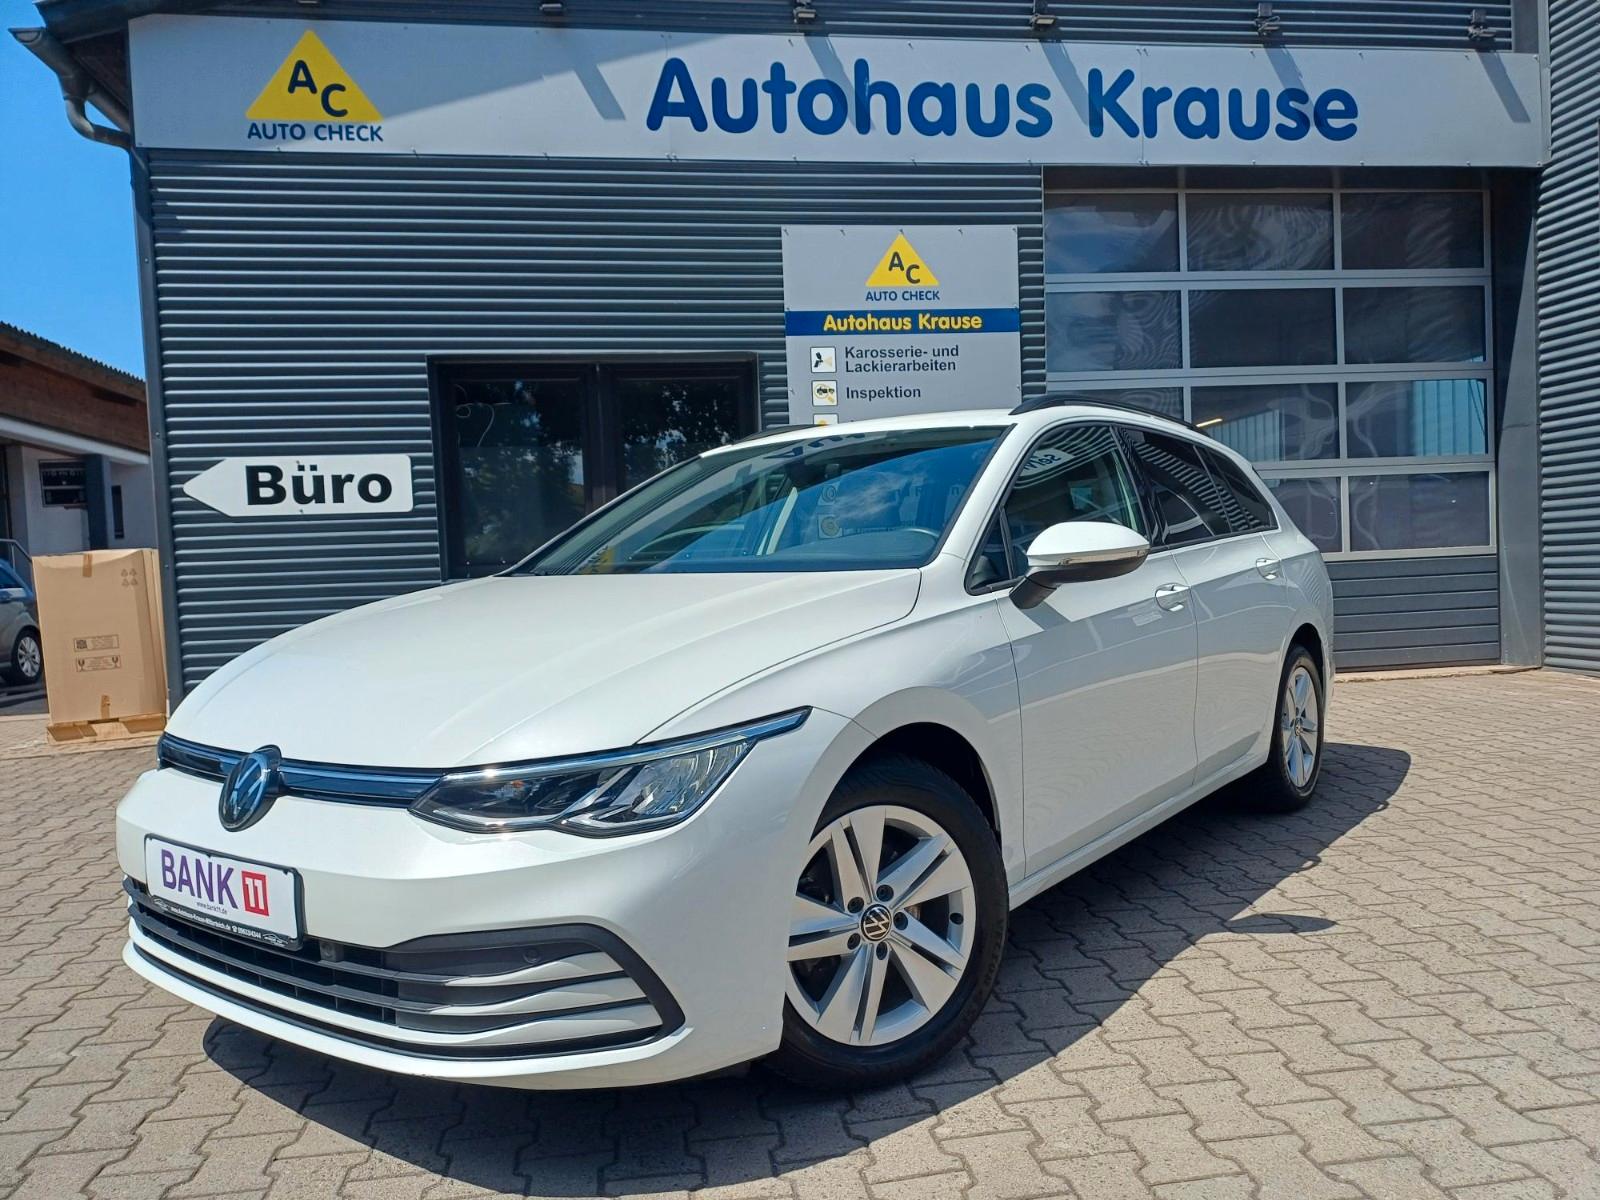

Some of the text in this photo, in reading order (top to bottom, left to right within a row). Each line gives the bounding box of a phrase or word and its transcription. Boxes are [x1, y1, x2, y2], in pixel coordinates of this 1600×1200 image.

[646, 57, 1359, 142] Autohaus Krause
[247, 122, 384, 142] AUTO CHECK
[865, 290, 940, 301] AUTO CHECK
[823, 313, 983, 332] Autohaus Krause
[845, 344, 959, 359] Karosserie- und
[845, 359, 956, 373] Lackierarbeiten
[846, 386, 921, 402] Inspektion
[245, 464, 393, 506] Büro
[161, 848, 239, 910] BANK
